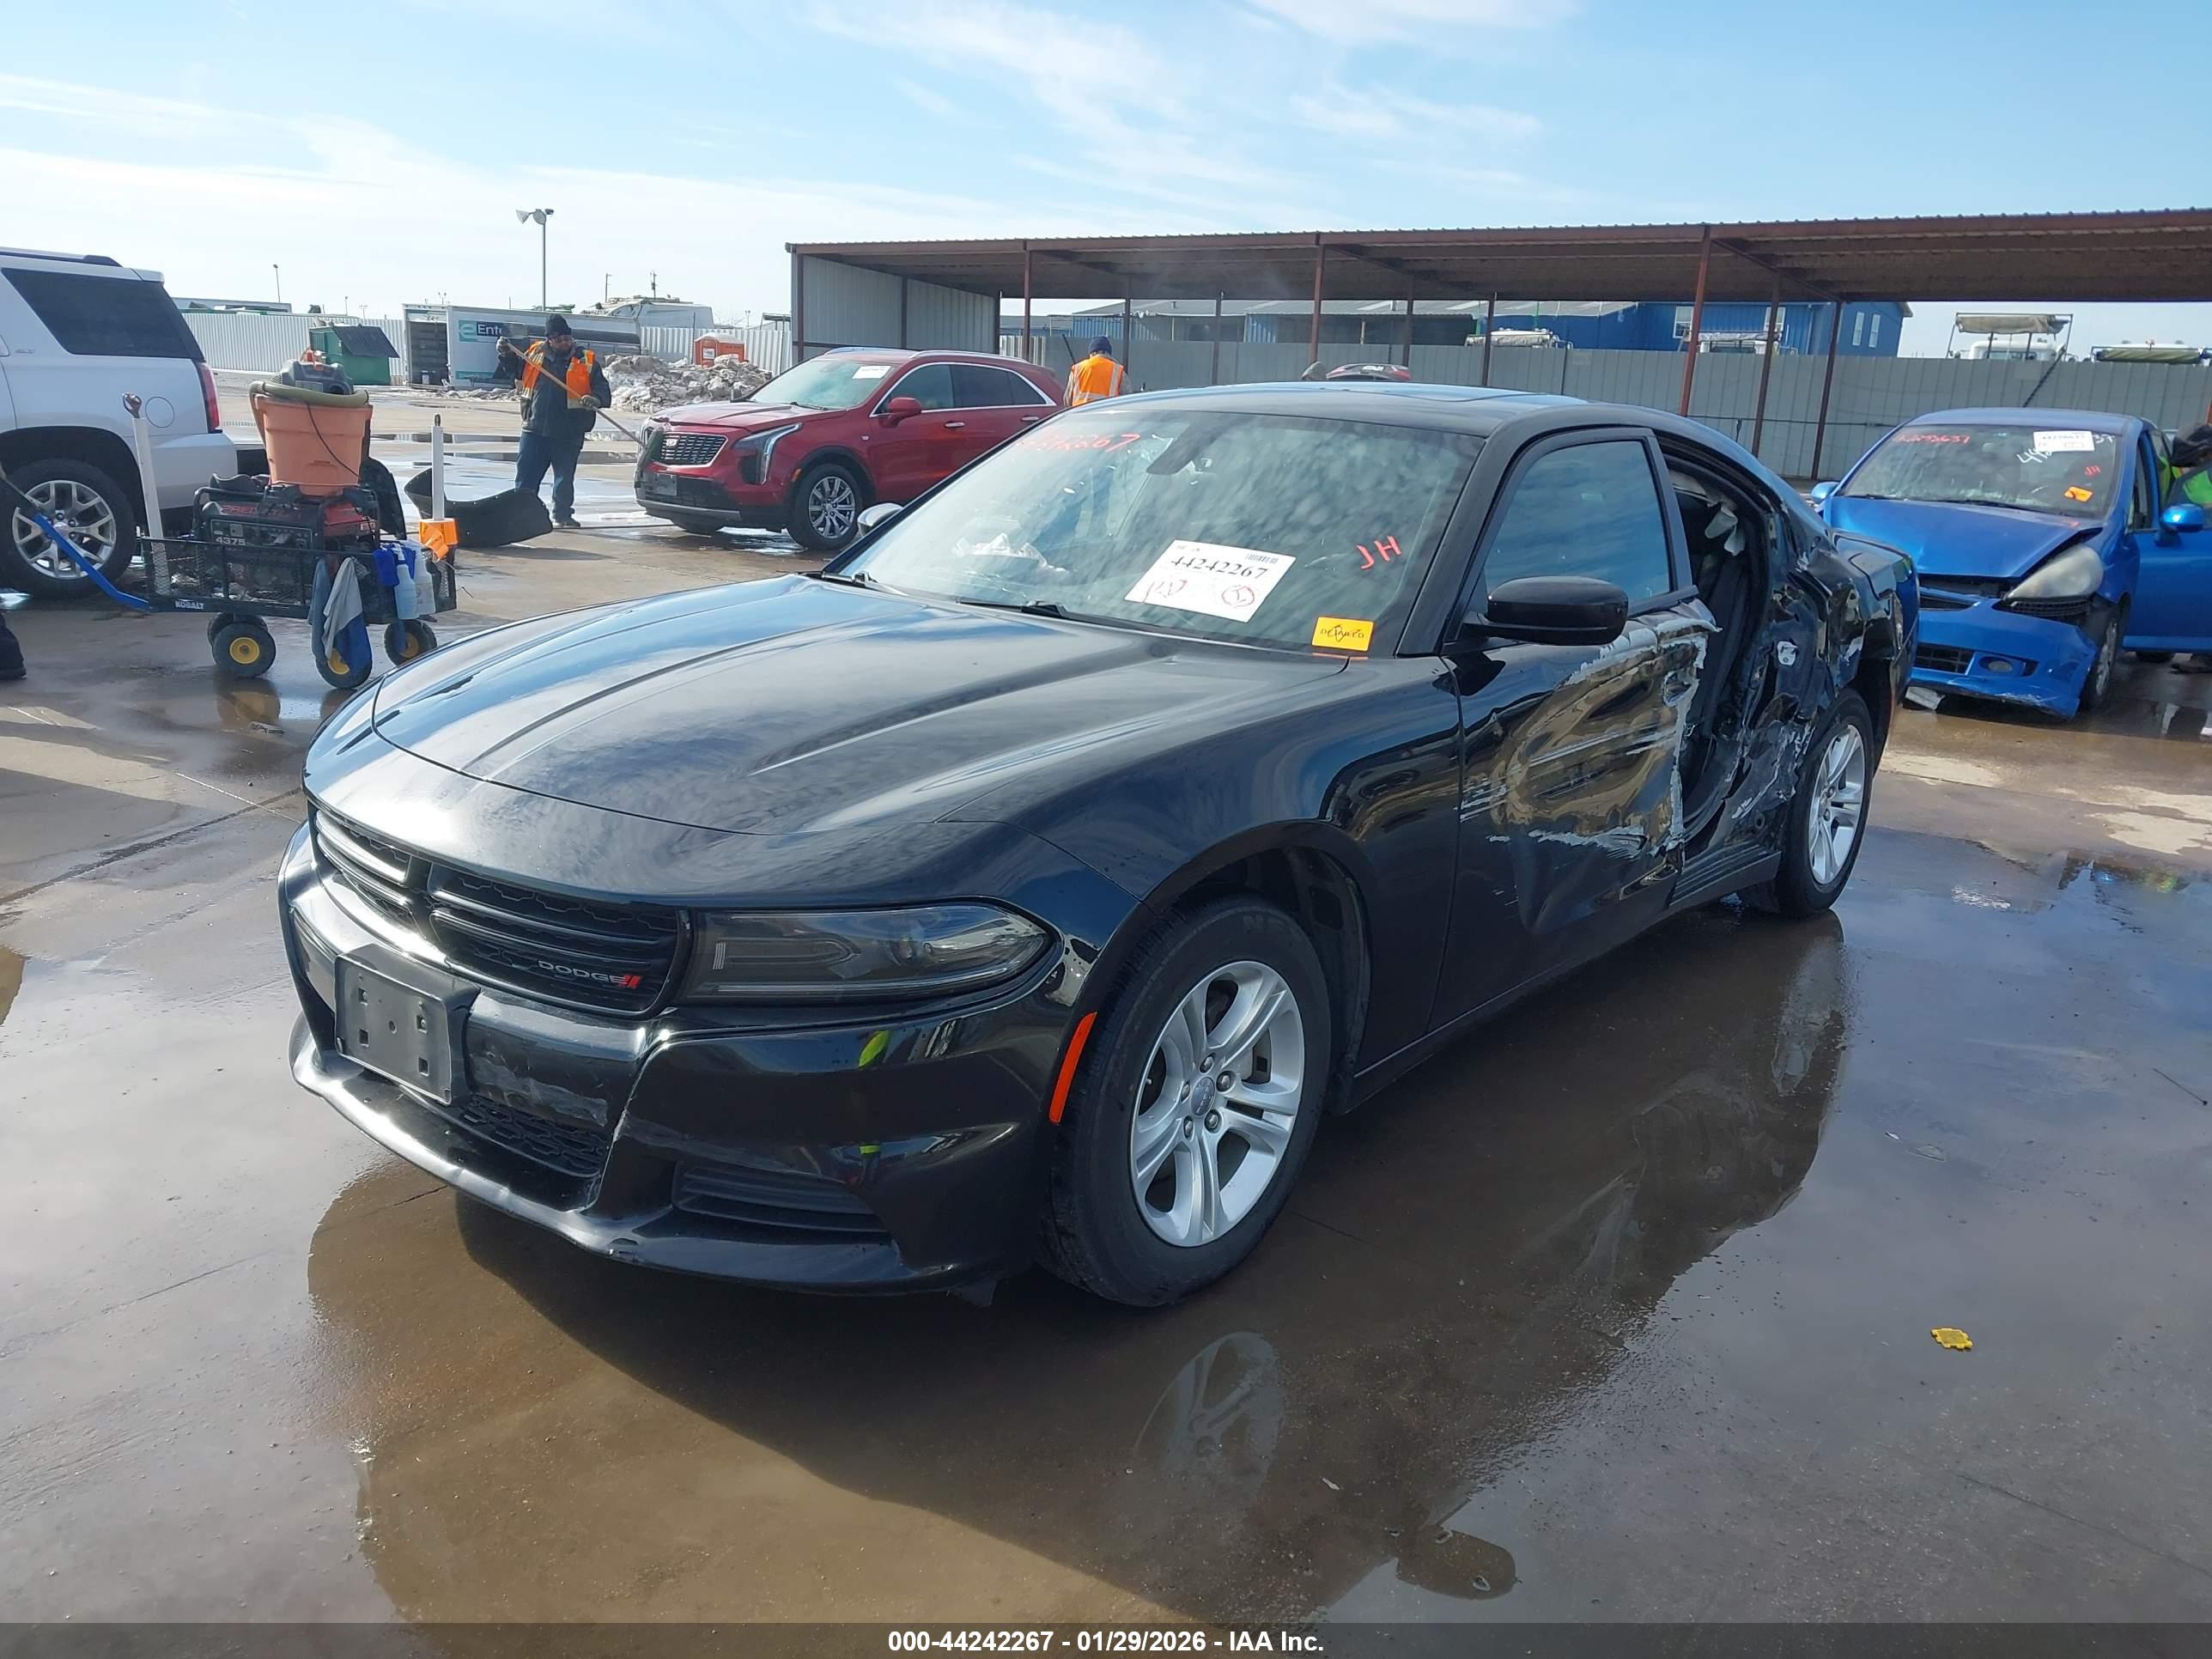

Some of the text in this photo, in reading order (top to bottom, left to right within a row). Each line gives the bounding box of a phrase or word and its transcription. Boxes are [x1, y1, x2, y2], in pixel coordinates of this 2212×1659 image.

[216, 537, 246, 546] 4375
[1356, 535, 1402, 570] JH
[1170, 556, 1269, 579] 44242267
[174, 600, 205, 610] KOBALT
[538, 960, 629, 985] DODGE
